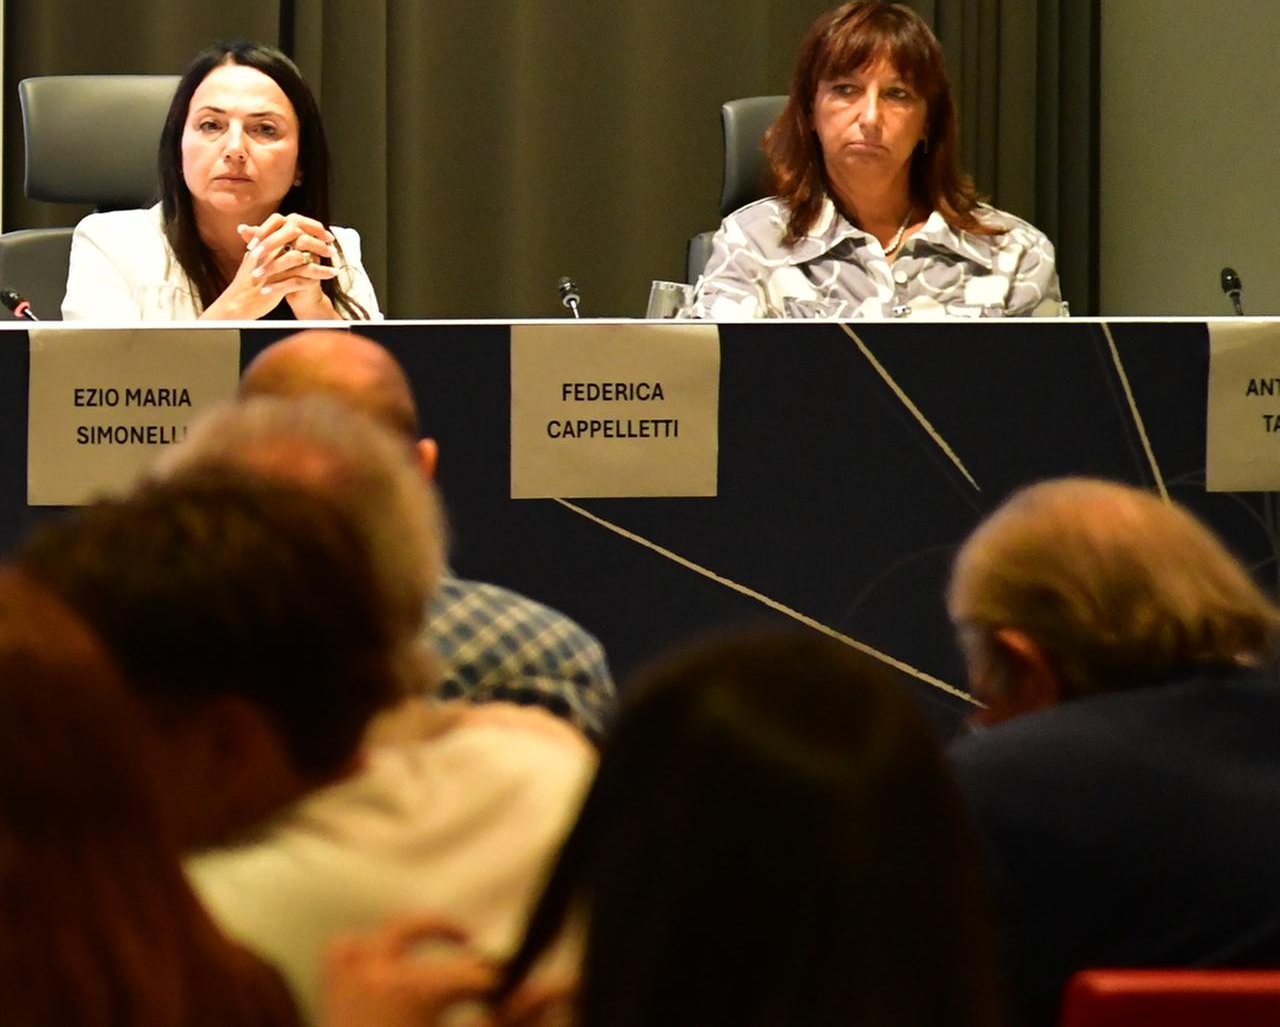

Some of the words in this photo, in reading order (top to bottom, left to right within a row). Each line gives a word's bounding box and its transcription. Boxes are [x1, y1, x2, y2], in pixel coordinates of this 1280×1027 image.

[73, 388, 120, 408] EZIO
[125, 388, 192, 407] MARIA
[562, 382, 665, 402] FEDERICA
[546, 419, 679, 439] CAPPELLETTI
